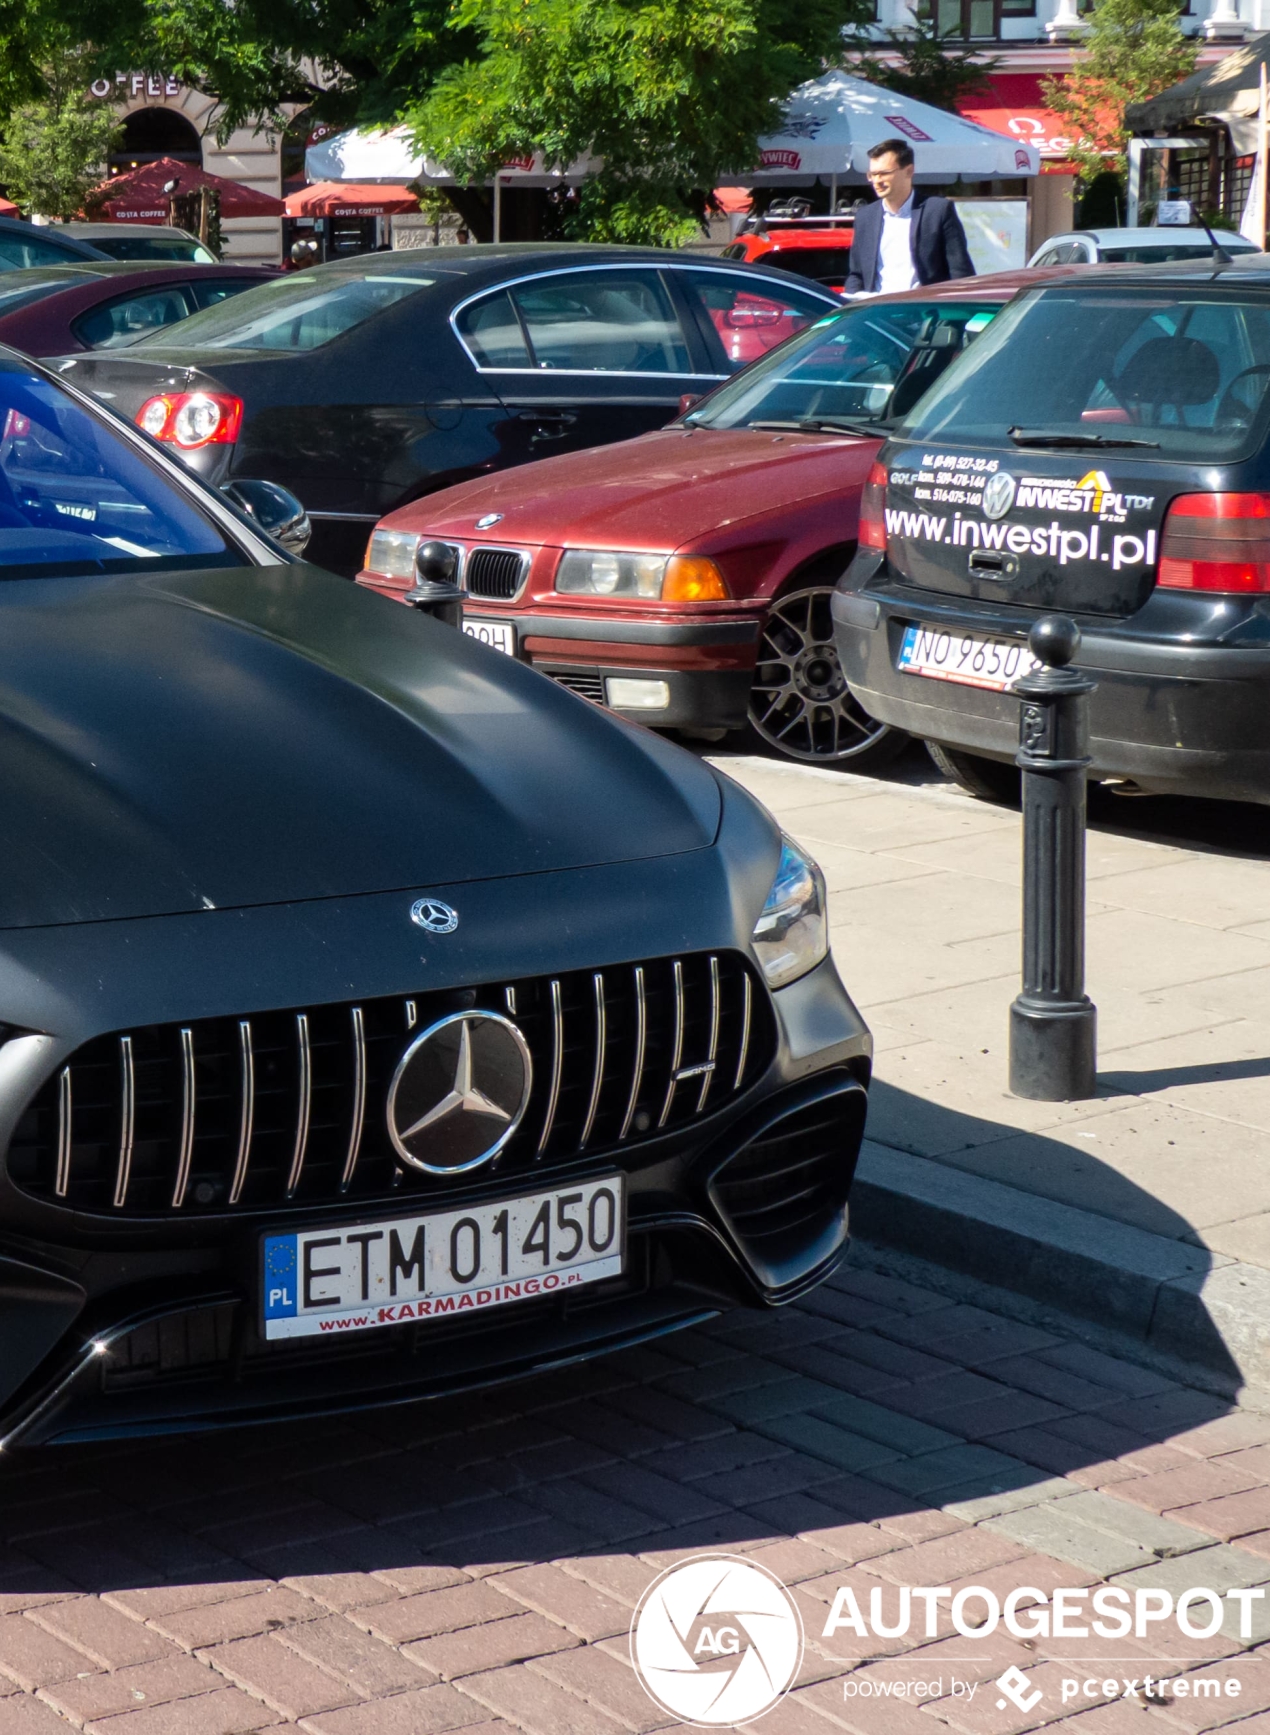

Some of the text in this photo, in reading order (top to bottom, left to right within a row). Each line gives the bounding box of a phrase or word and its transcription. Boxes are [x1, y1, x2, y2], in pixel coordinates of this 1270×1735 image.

[335, 208, 357, 216] COSTA
[956, 456, 999, 473] 527-32-45
[890, 472, 918, 485] GOLF
[932, 488, 982, 506] 516-075-160
[1125, 495, 1155, 510] TDI
[885, 508, 1156, 570] www.inwestpl.pl
[916, 627, 951, 664] NO
[303, 1187, 616, 1309] ETM 01450
[269, 1288, 292, 1307] PL
[319, 1273, 583, 1331] www.KARMADINGO.PL
